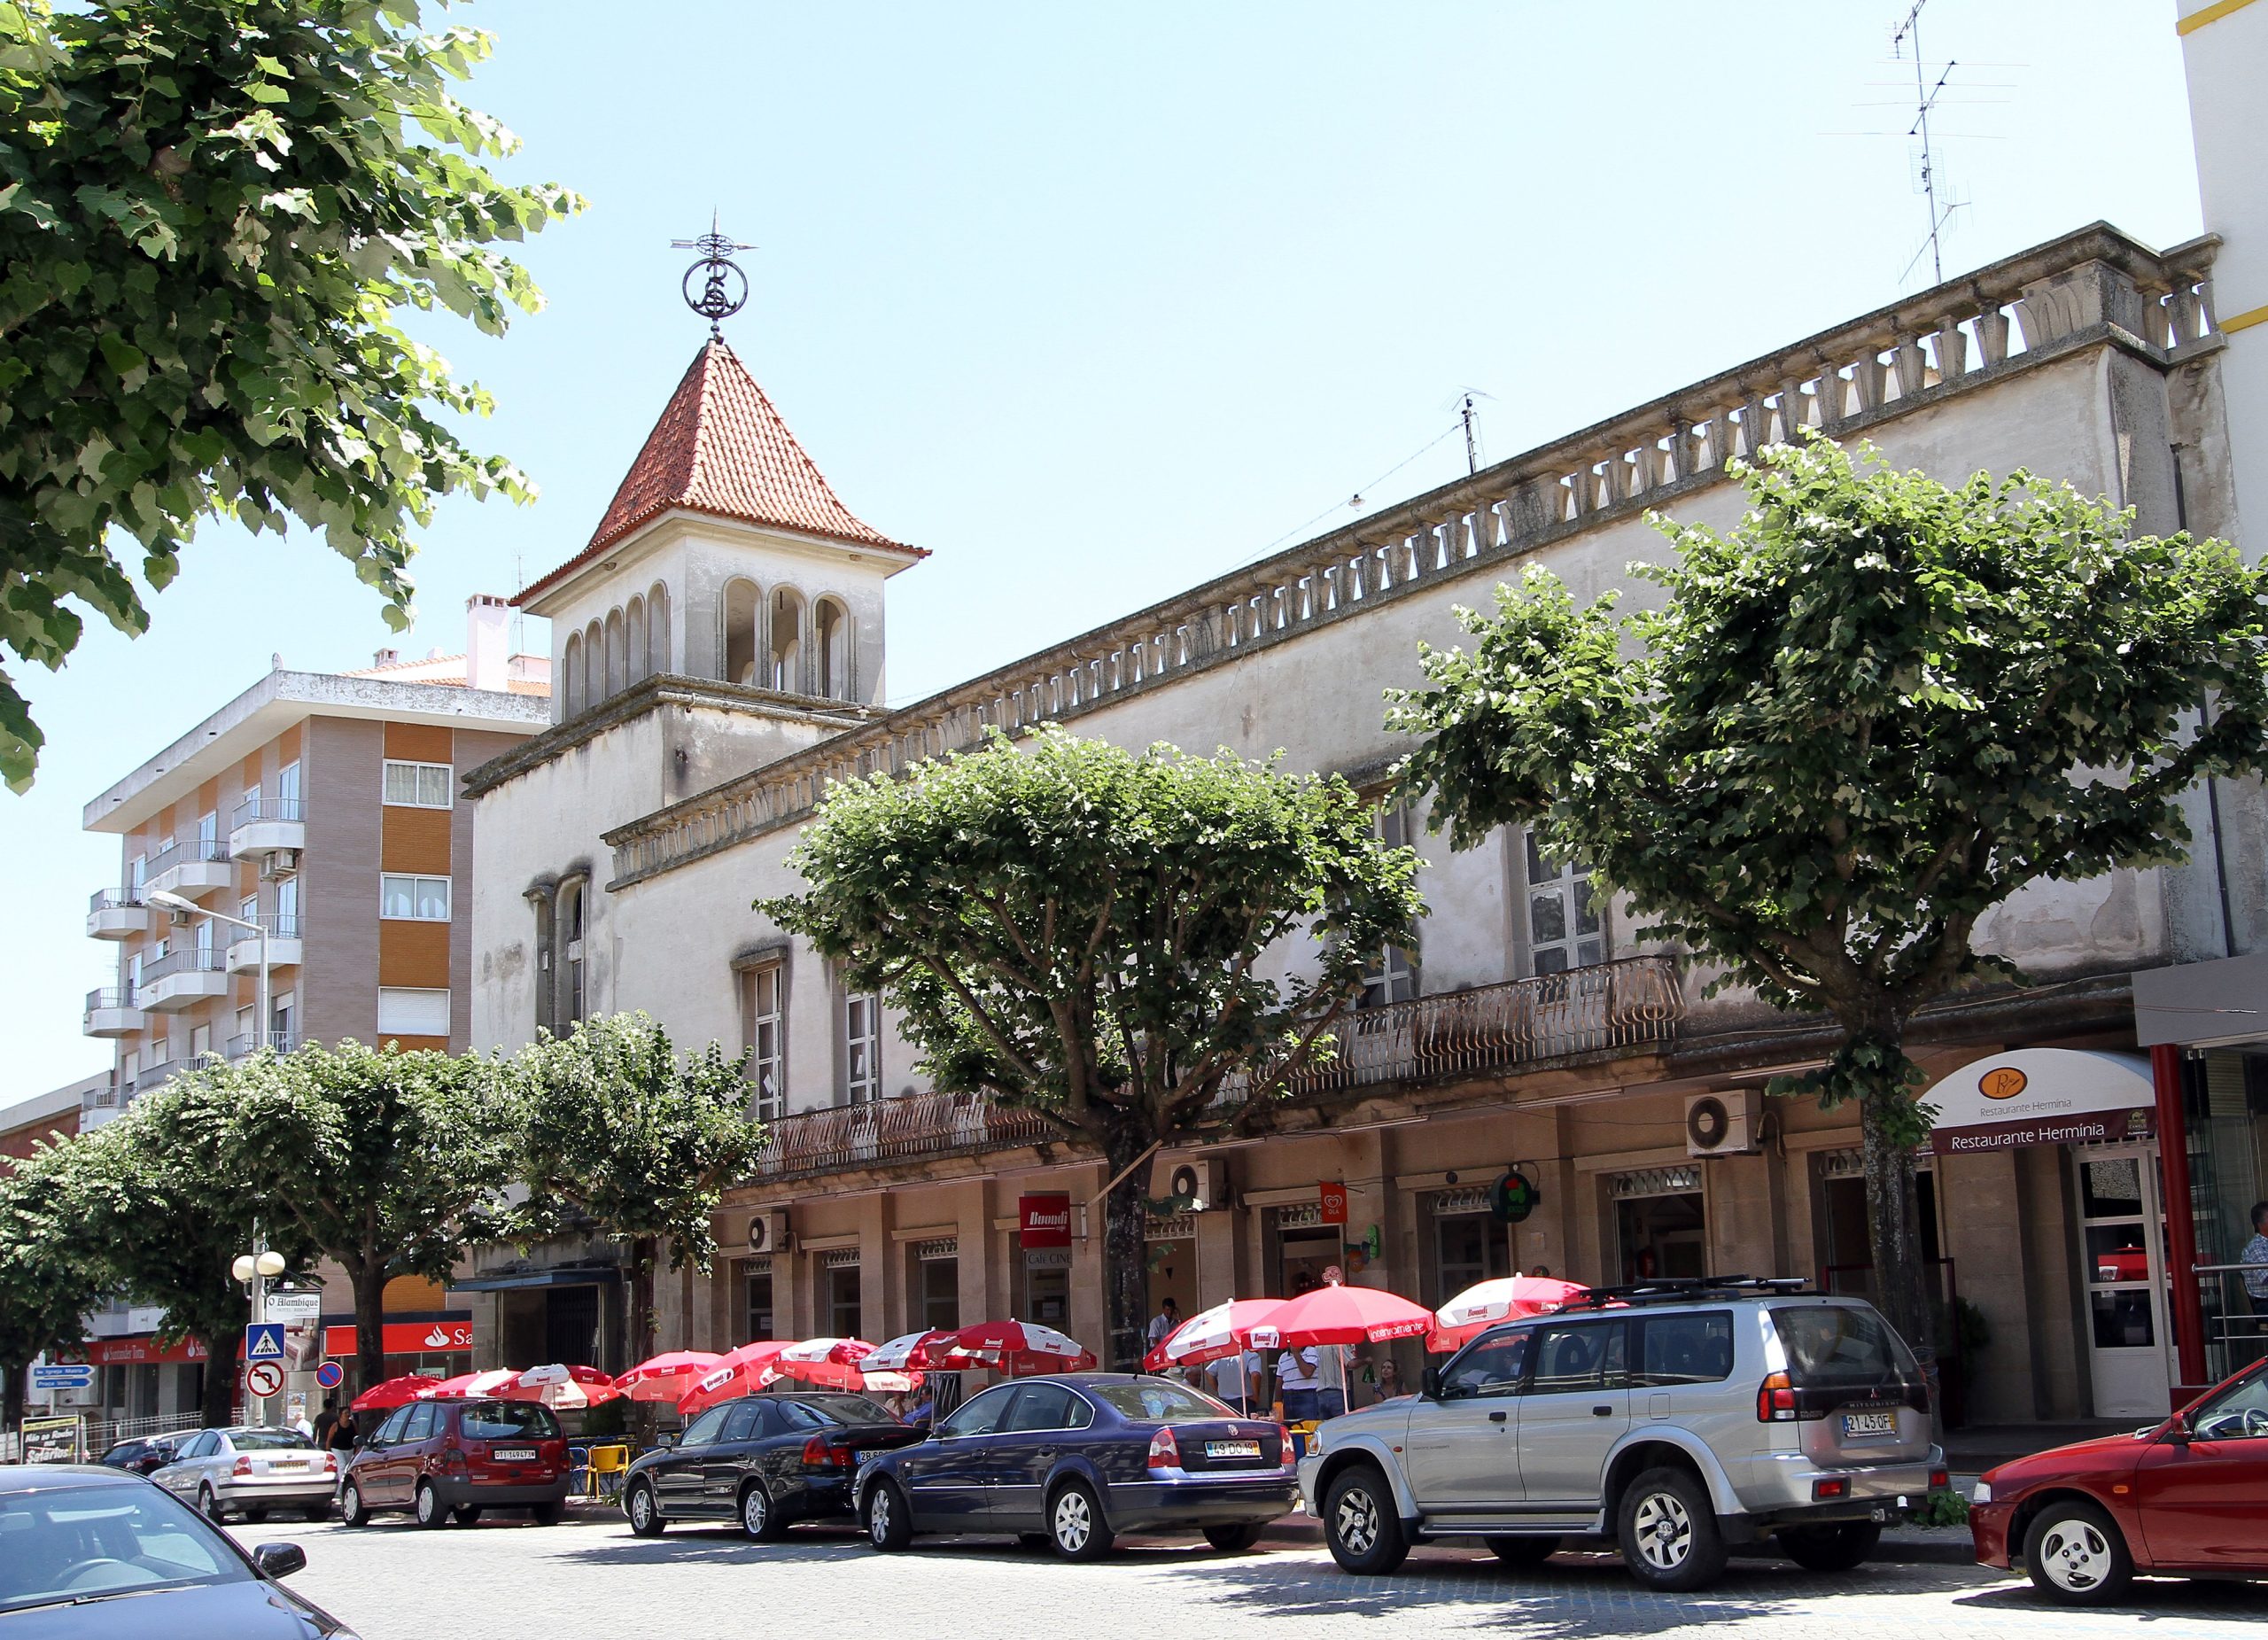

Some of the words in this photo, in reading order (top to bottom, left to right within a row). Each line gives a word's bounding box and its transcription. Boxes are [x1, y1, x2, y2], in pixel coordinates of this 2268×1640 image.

[1980, 1104, 2030, 1117] Restaurante
[2032, 1099, 2072, 1111] Hermínia
[1952, 1131, 2035, 1149] Restaurante
[2039, 1123, 2105, 1141] Hermínia
[1029, 1210, 1068, 1224] Buondi
[1028, 1253, 1046, 1264] Café
[277, 1296, 319, 1307] Alambique
[1467, 1306, 1488, 1317] Buondi
[1254, 1333, 1271, 1343] Buondi
